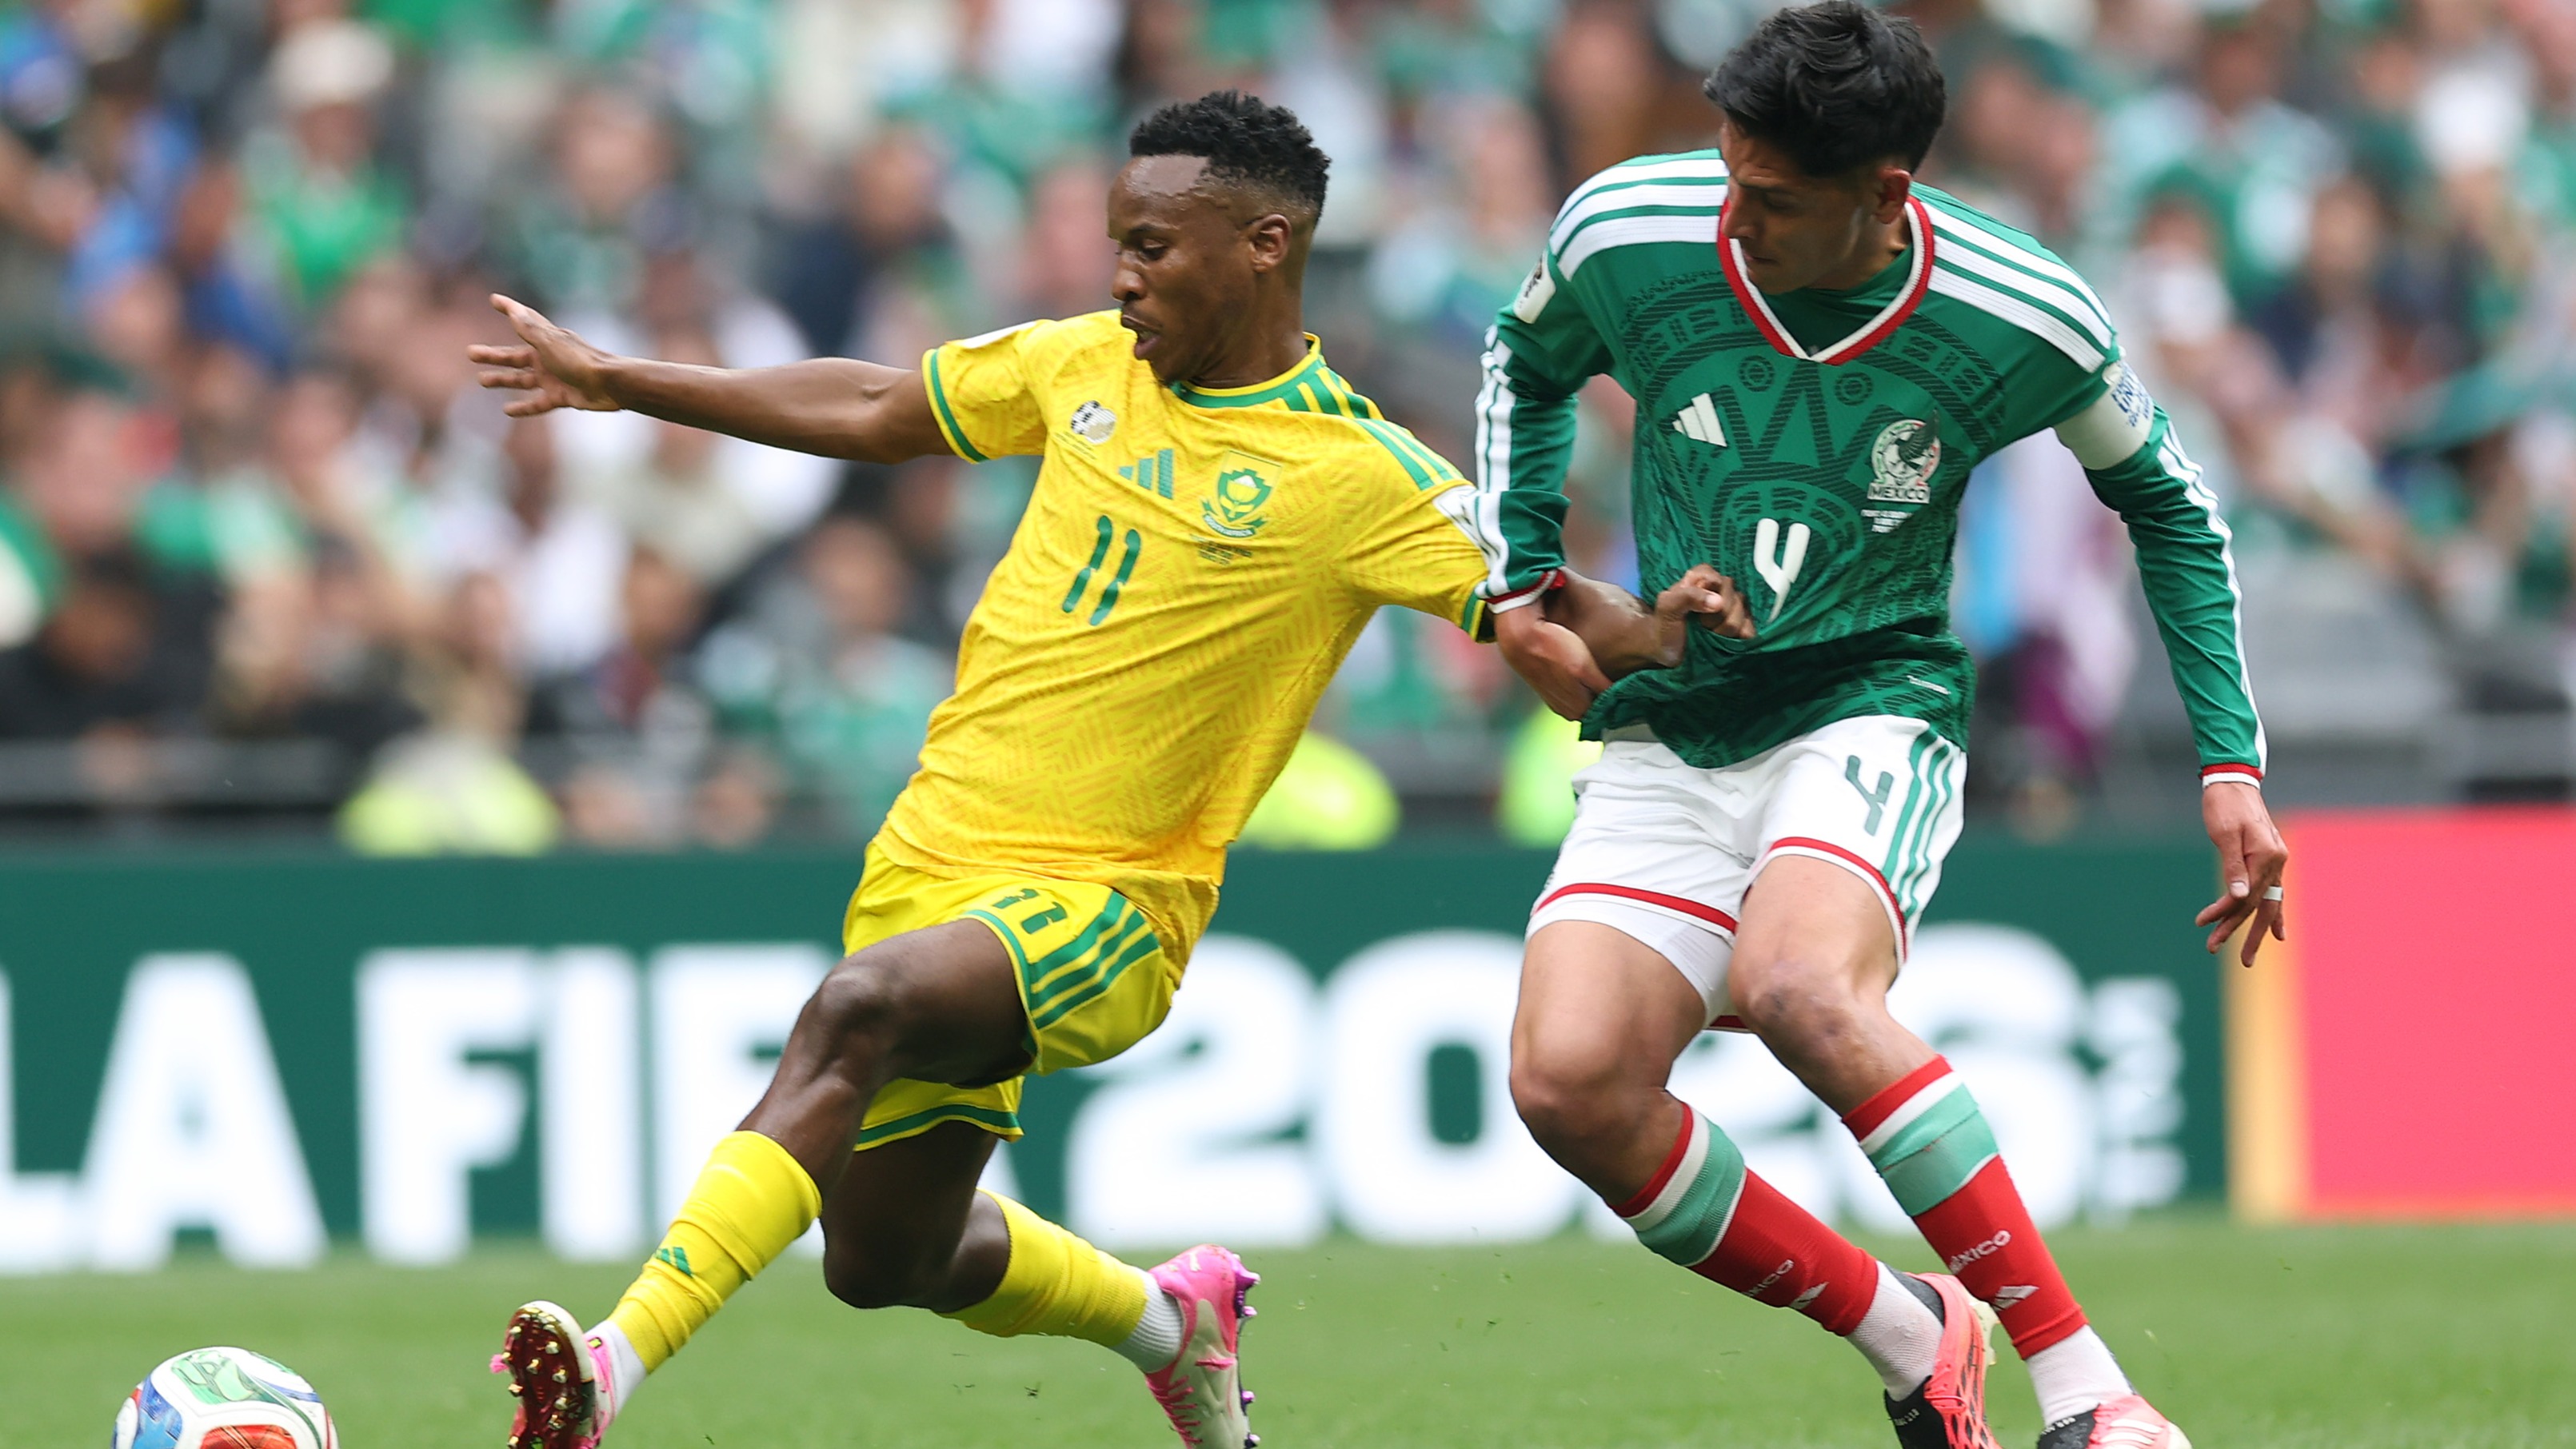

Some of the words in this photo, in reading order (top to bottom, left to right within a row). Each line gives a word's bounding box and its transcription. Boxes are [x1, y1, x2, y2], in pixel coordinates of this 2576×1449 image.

[1061, 515, 1140, 626] 11
[1753, 517, 1811, 623] 4
[1845, 754, 1894, 836] 4
[992, 888, 1068, 935] 11
[354, 942, 1025, 1267] FIF
